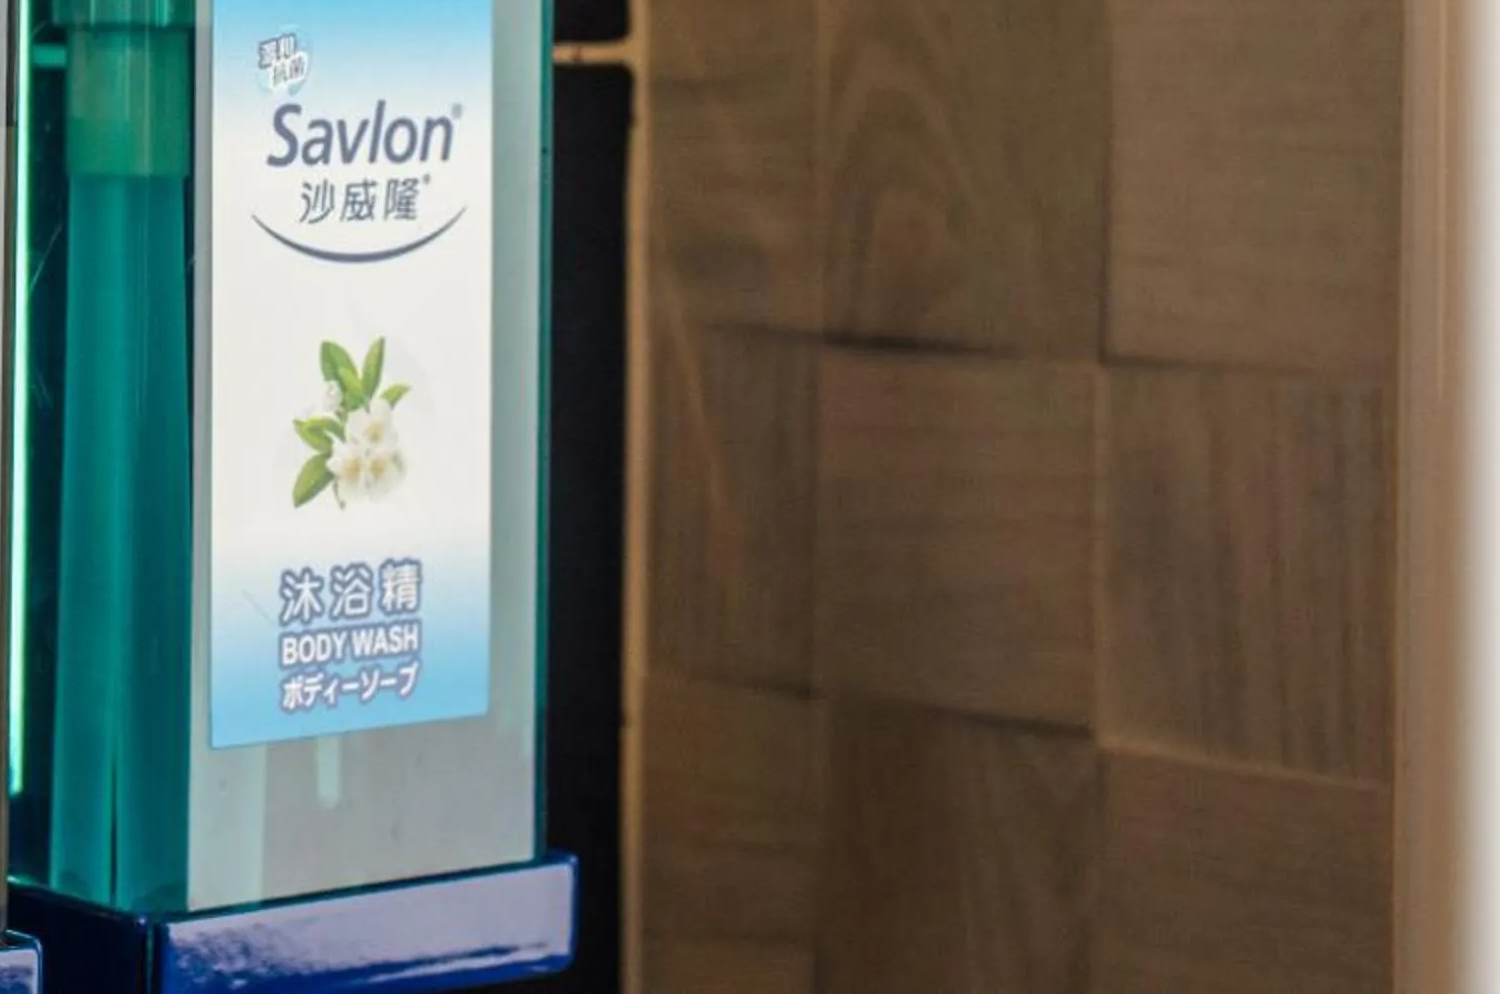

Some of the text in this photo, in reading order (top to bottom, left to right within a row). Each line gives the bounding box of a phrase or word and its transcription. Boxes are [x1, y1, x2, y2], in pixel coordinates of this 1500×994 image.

[281, 562, 421, 623] 沐浴精
[282, 623, 419, 666] BODY WASH
